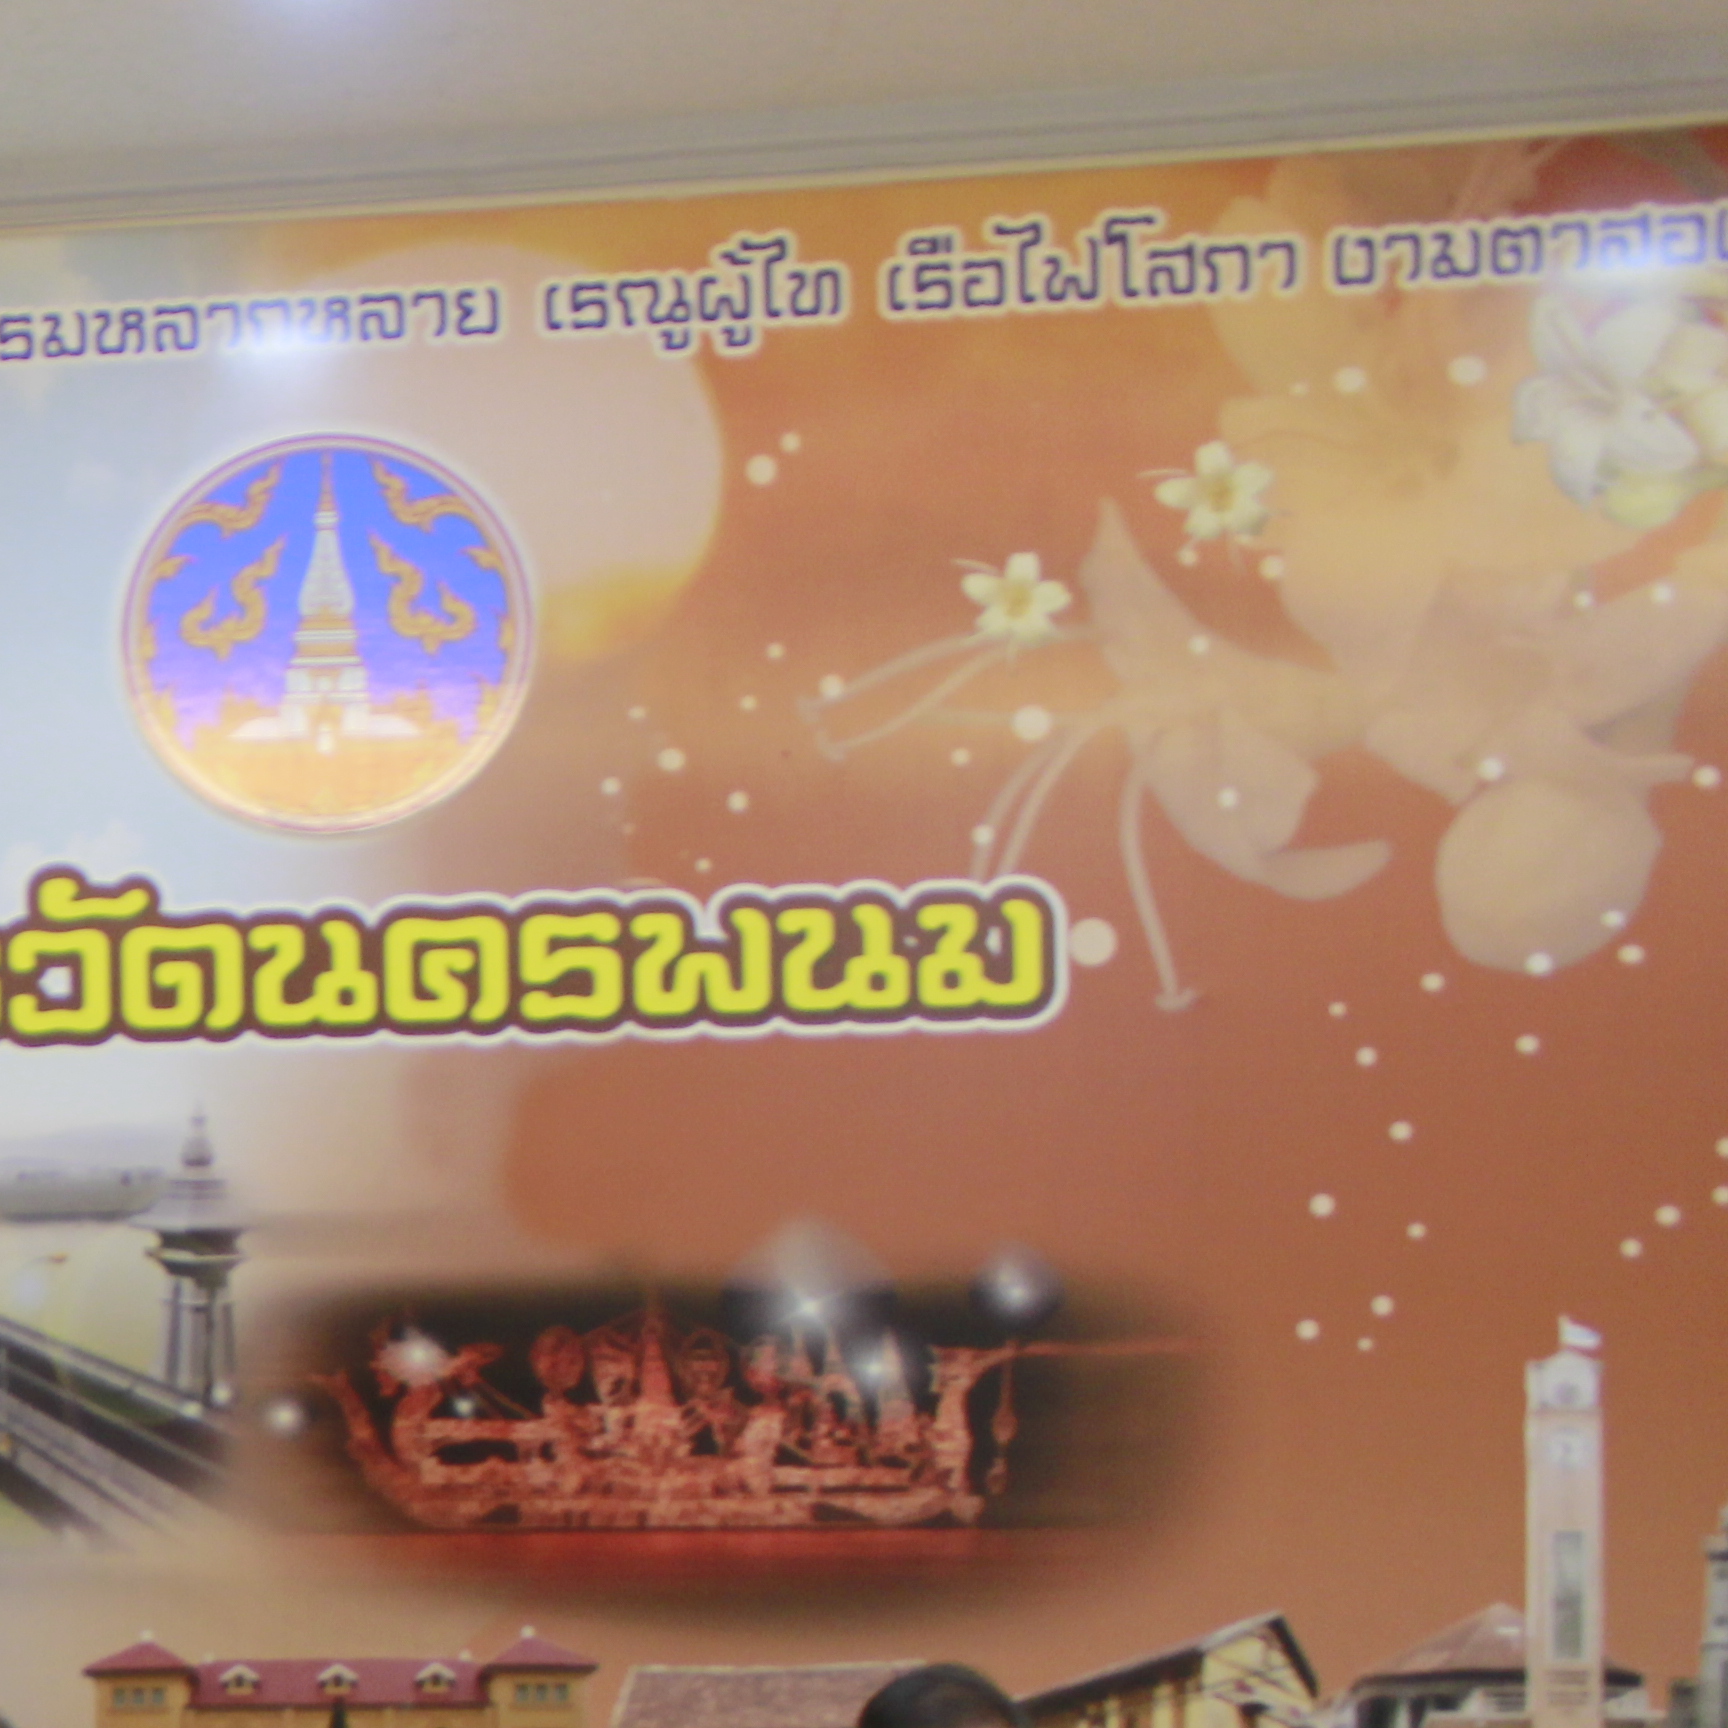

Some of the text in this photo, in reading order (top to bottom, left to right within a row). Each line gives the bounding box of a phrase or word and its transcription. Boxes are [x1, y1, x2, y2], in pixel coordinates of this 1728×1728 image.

[543, 237, 842, 351] เรณูผู้ไท
[888, 214, 1300, 312] เรือไฟโสภา
